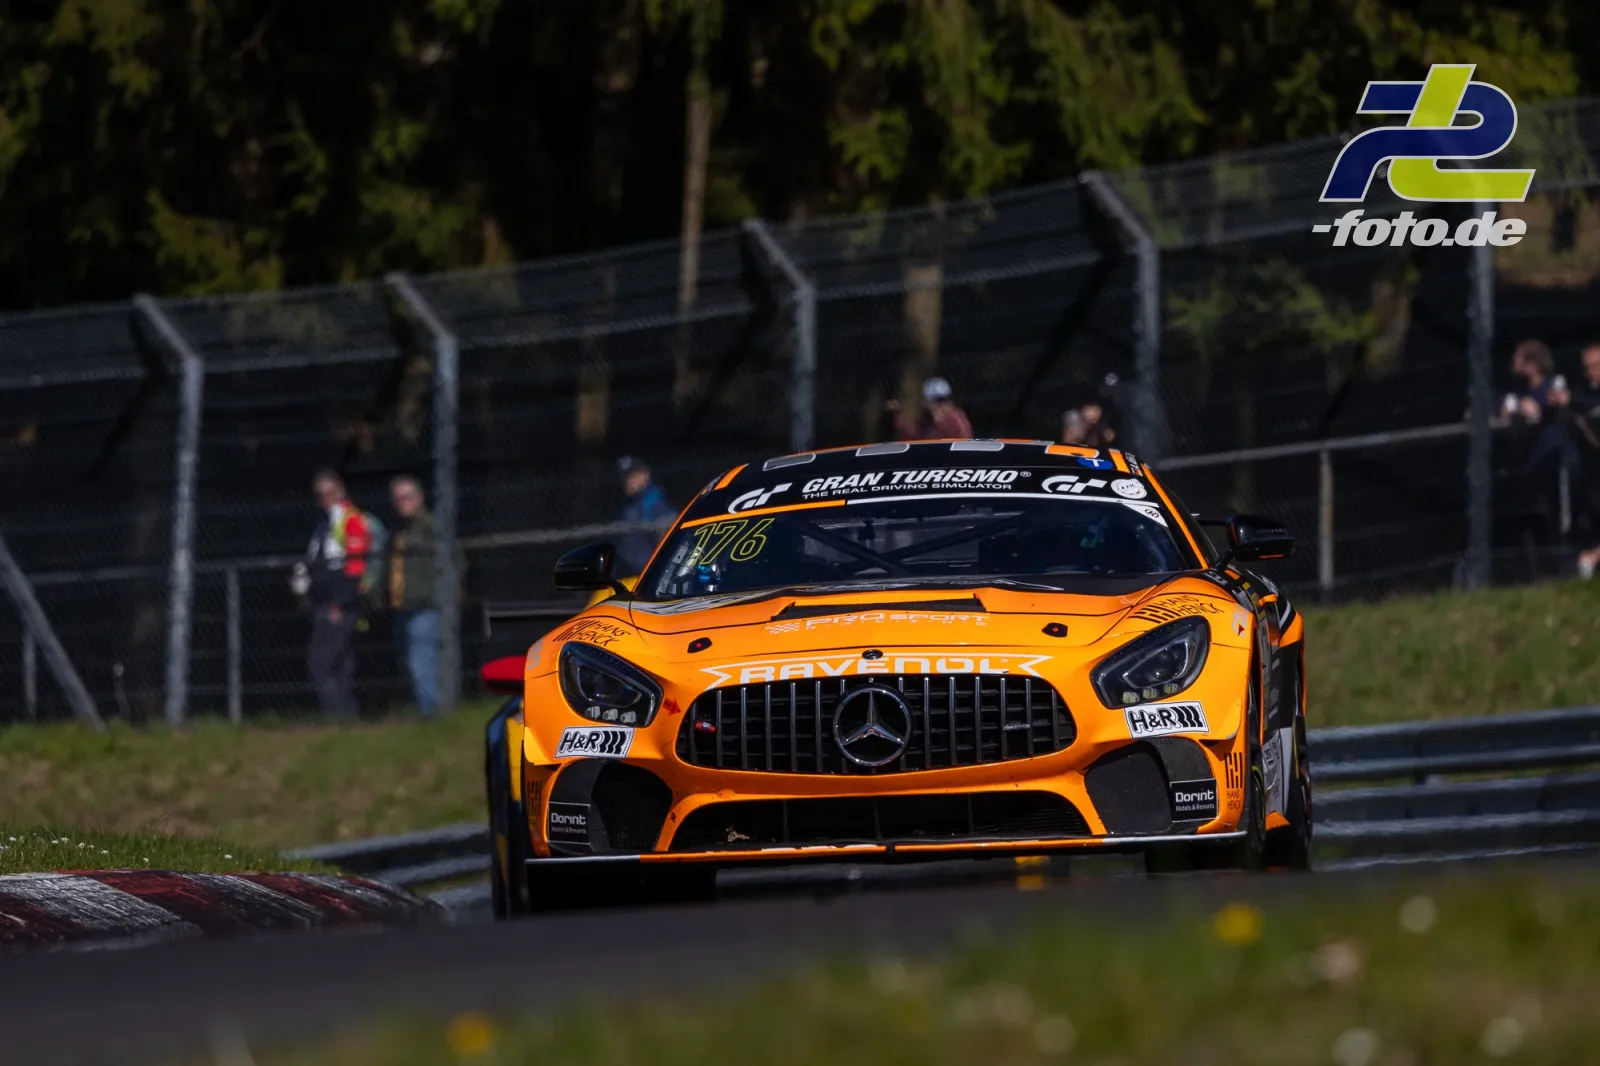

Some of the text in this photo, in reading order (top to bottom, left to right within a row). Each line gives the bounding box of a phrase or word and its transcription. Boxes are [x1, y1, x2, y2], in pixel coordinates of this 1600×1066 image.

[801, 472, 885, 493] GRAN
[802, 490, 828, 500] THE
[832, 486, 868, 496] REAL
[871, 483, 928, 492] DRIVING
[687, 517, 776, 567] 176
[1128, 708, 1177, 732] H&R
[559, 731, 602, 752] H&R
[1175, 789, 1215, 803] Dorint
[1175, 804, 1191, 812] Hotels
[551, 812, 587, 826] Dorint
